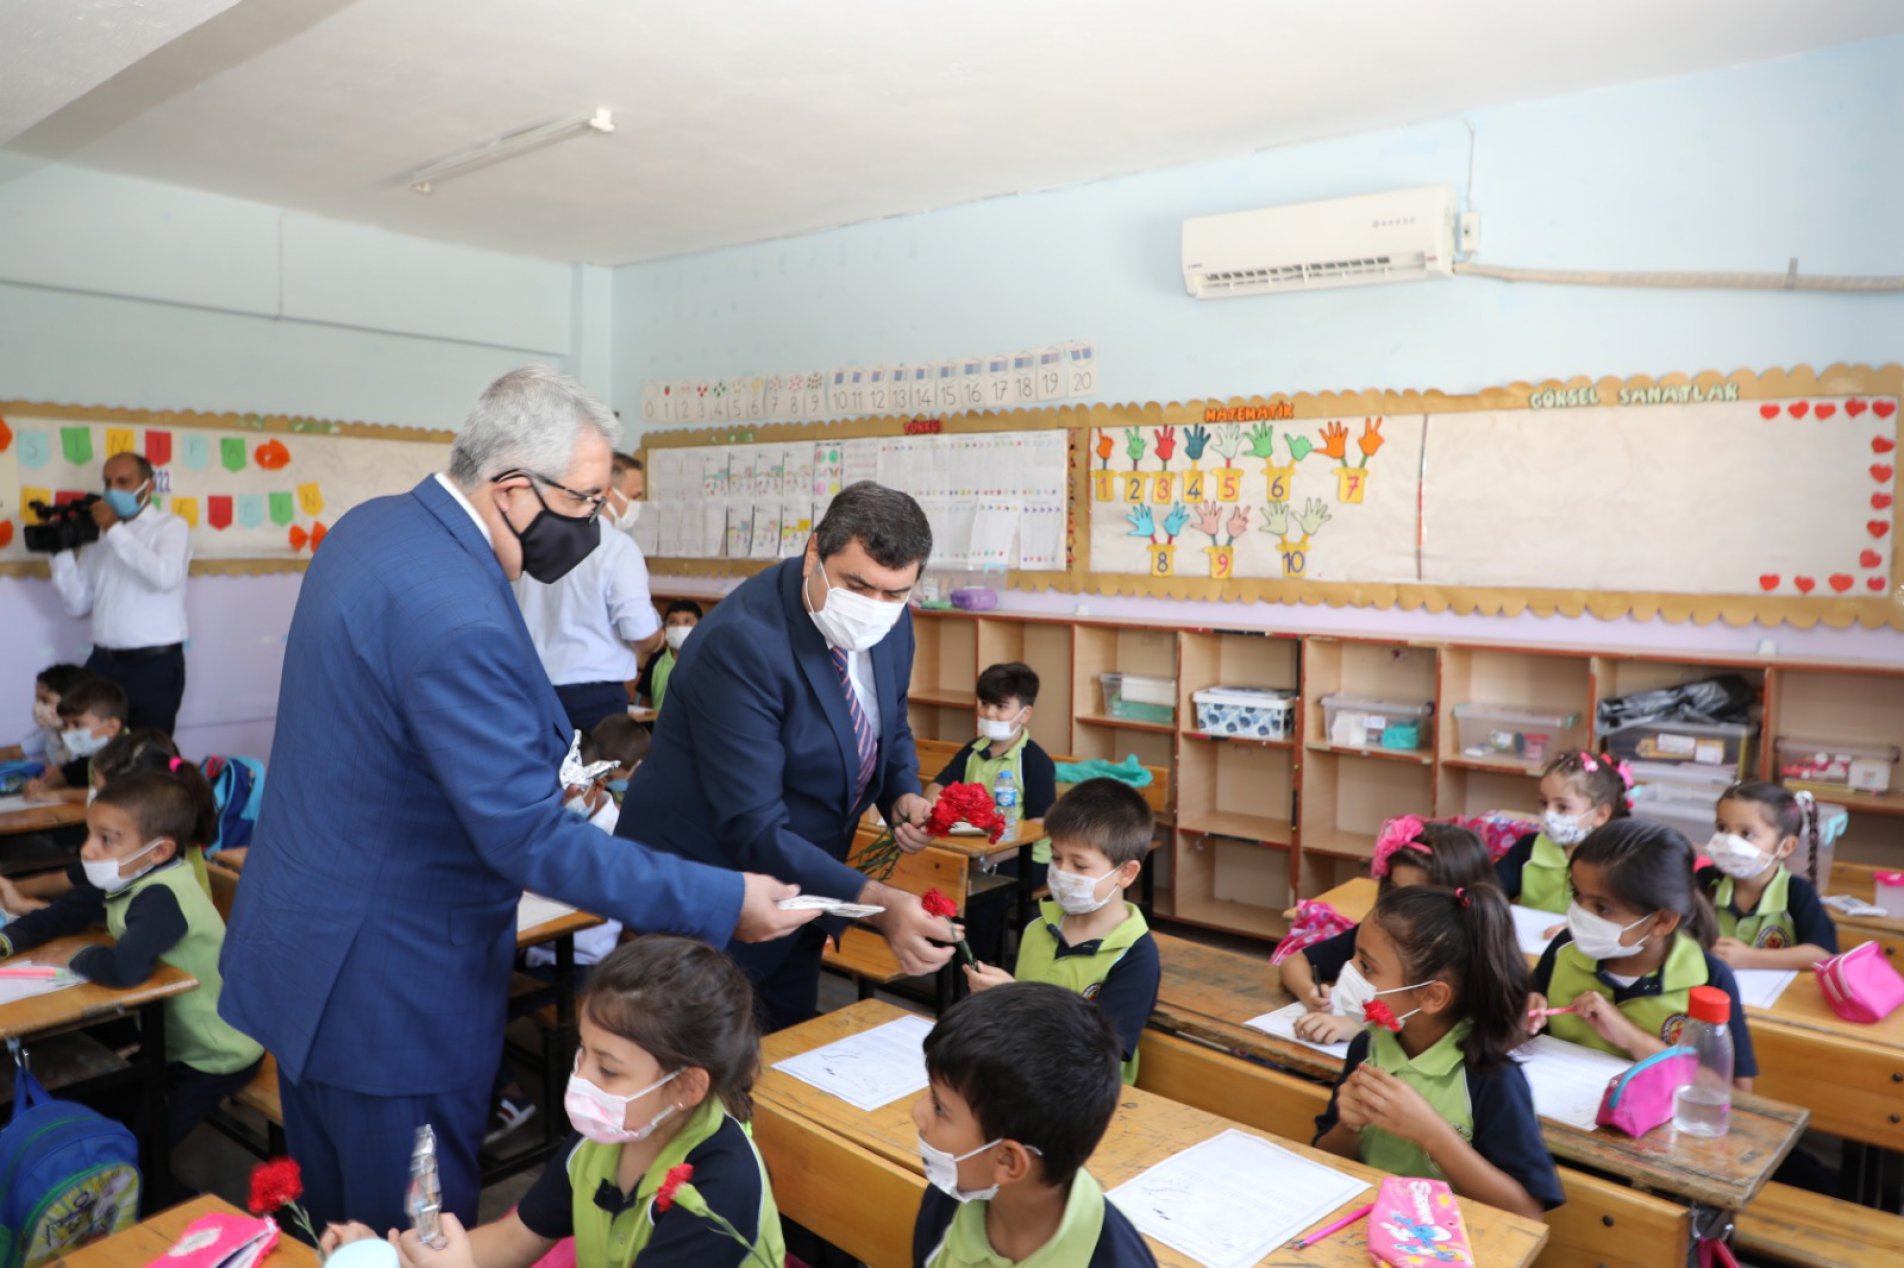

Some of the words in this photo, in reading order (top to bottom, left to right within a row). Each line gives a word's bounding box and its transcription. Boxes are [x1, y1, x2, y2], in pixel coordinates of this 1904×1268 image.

[644, 401, 654, 418] 0
[664, 402, 669, 418] 1
[681, 400, 689, 418] 2
[697, 401, 705, 417] 3
[714, 401, 722, 417] 4
[733, 400, 741, 416] 5
[752, 400, 759, 415] 6
[772, 396, 779, 414] 7
[790, 396, 798, 414] 8
[811, 394, 819, 413] 9
[832, 391, 848, 409] 10
[852, 391, 863, 409] 11
[870, 389, 886, 409] 12
[893, 388, 907, 409] 13
[915, 387, 931, 407] 14
[941, 384, 957, 406] 15
[964, 383, 981, 402] 16
[992, 380, 1009, 401] 17
[1015, 376, 1033, 398] 18
[1043, 372, 1059, 394] 19
[1073, 371, 1092, 392] 20
[1100, 477, 1108, 498] 1
[1129, 478, 1141, 500] 2
[1156, 478, 1169, 500] 3
[1187, 479, 1202, 500] 4
[1223, 476, 1236, 498] 5
[1271, 475, 1285, 499] 6
[1346, 475, 1360, 500] 7
[1156, 551, 1169, 573] 8
[1216, 553, 1230, 576] 9
[1282, 550, 1306, 574] 10
